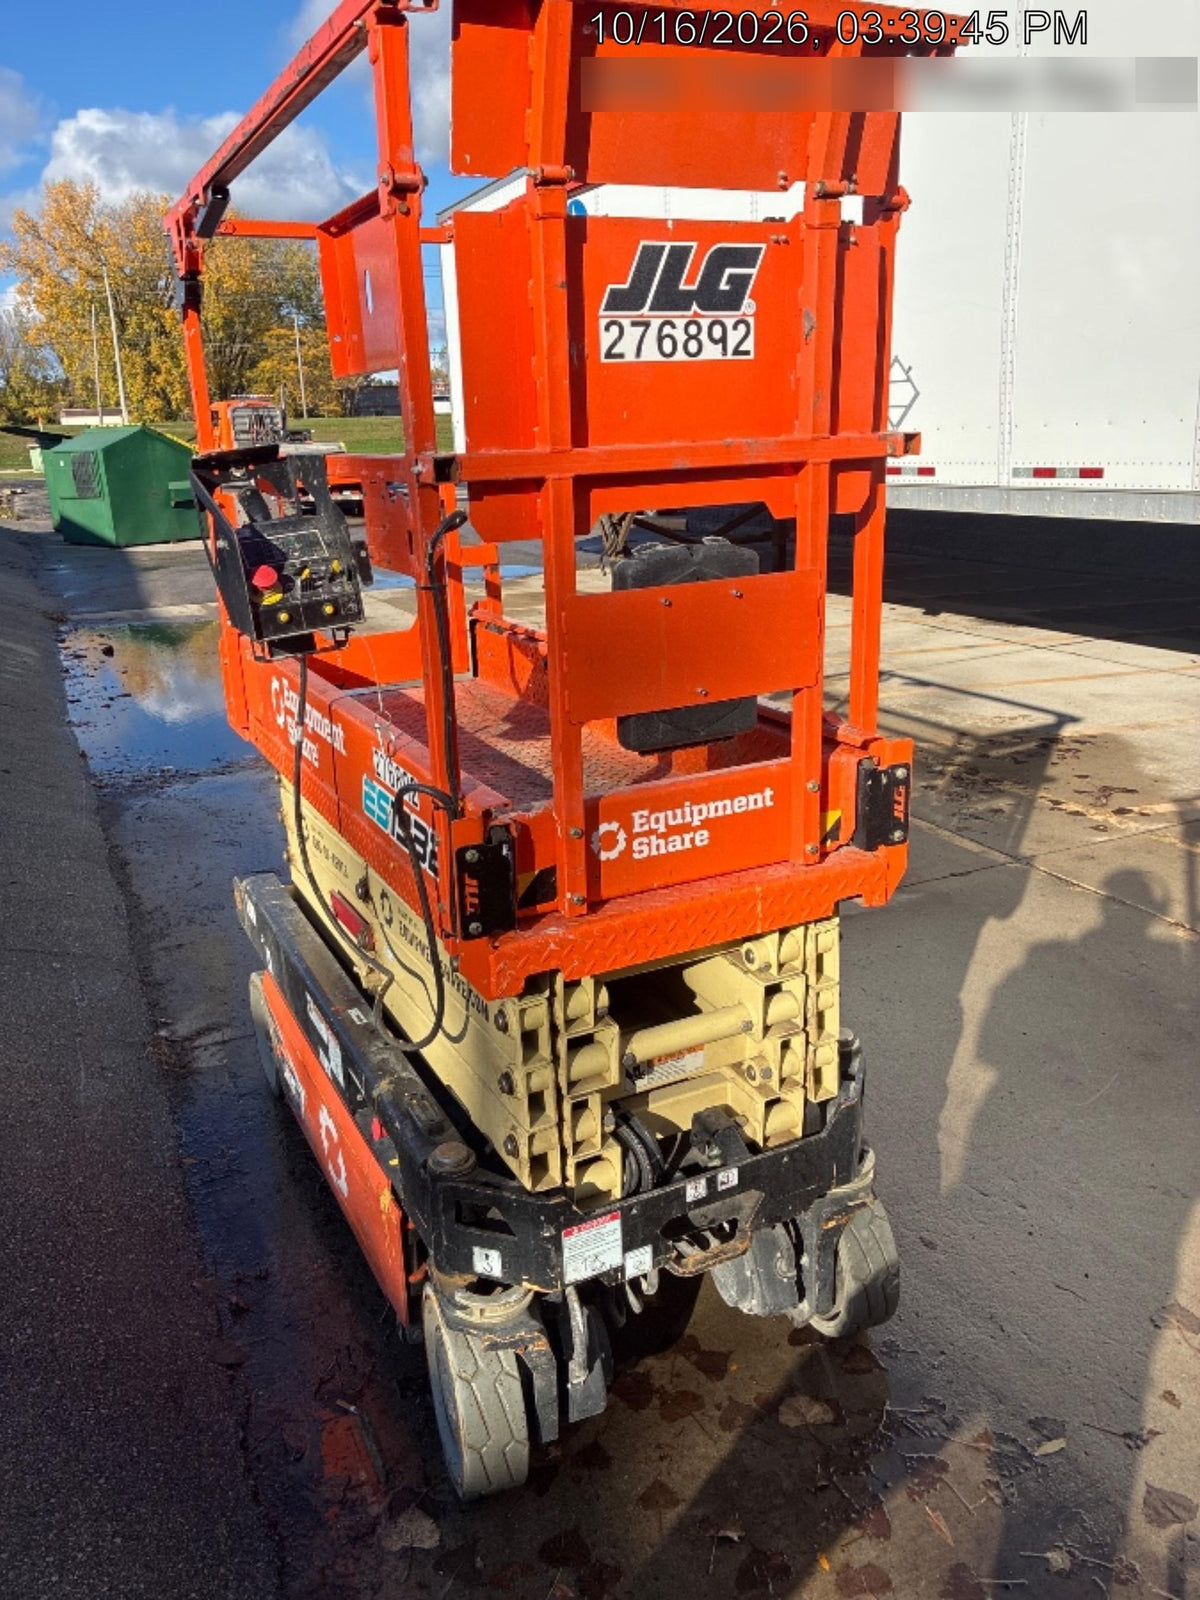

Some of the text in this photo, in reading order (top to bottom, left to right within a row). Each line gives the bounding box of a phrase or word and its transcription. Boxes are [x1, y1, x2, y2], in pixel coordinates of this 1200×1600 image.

[600, 241, 766, 315] JLG
[603, 318, 752, 360] 276892
[282, 677, 347, 757] Eqipment
[631, 787, 774, 833] Equipment
[631, 828, 710, 860] Share
